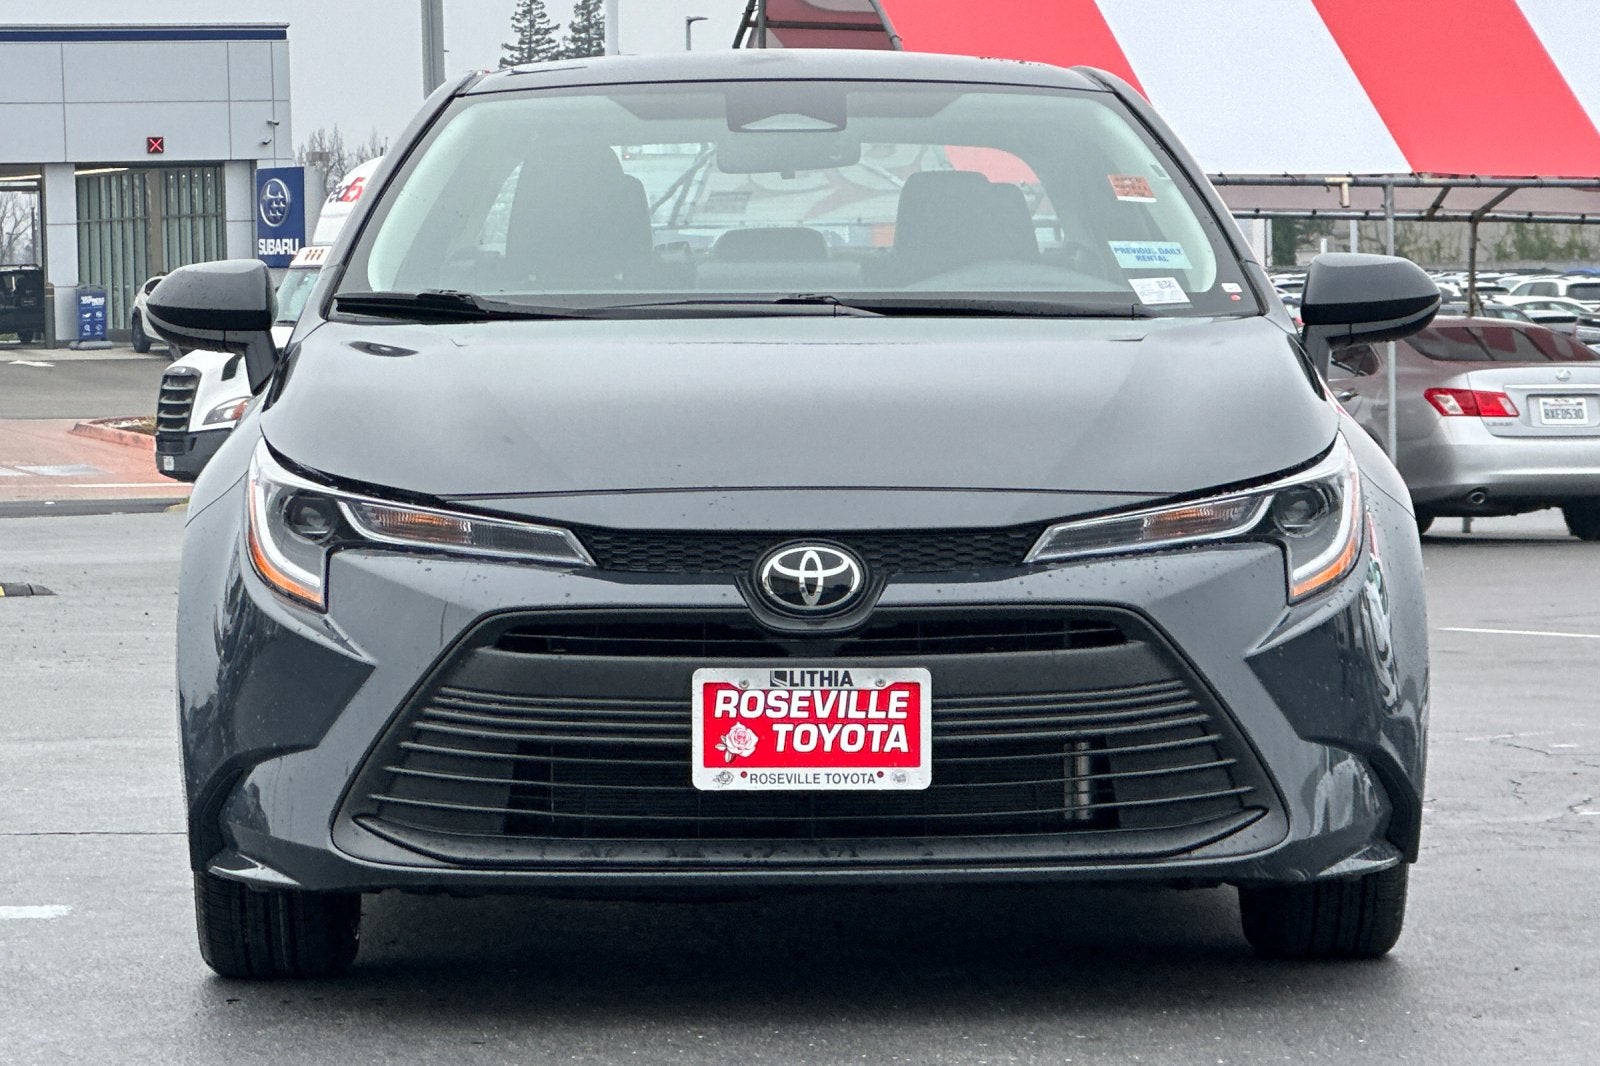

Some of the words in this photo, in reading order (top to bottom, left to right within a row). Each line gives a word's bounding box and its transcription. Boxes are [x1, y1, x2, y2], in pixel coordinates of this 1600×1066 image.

[258, 238, 299, 256] SUBARU
[789, 670, 853, 687] LITHIA
[713, 689, 910, 719] ROSEVILLE
[772, 723, 909, 753] TOYOTA
[749, 773, 821, 785] ROSEVILLE
[826, 773, 876, 785] TOYOTA
